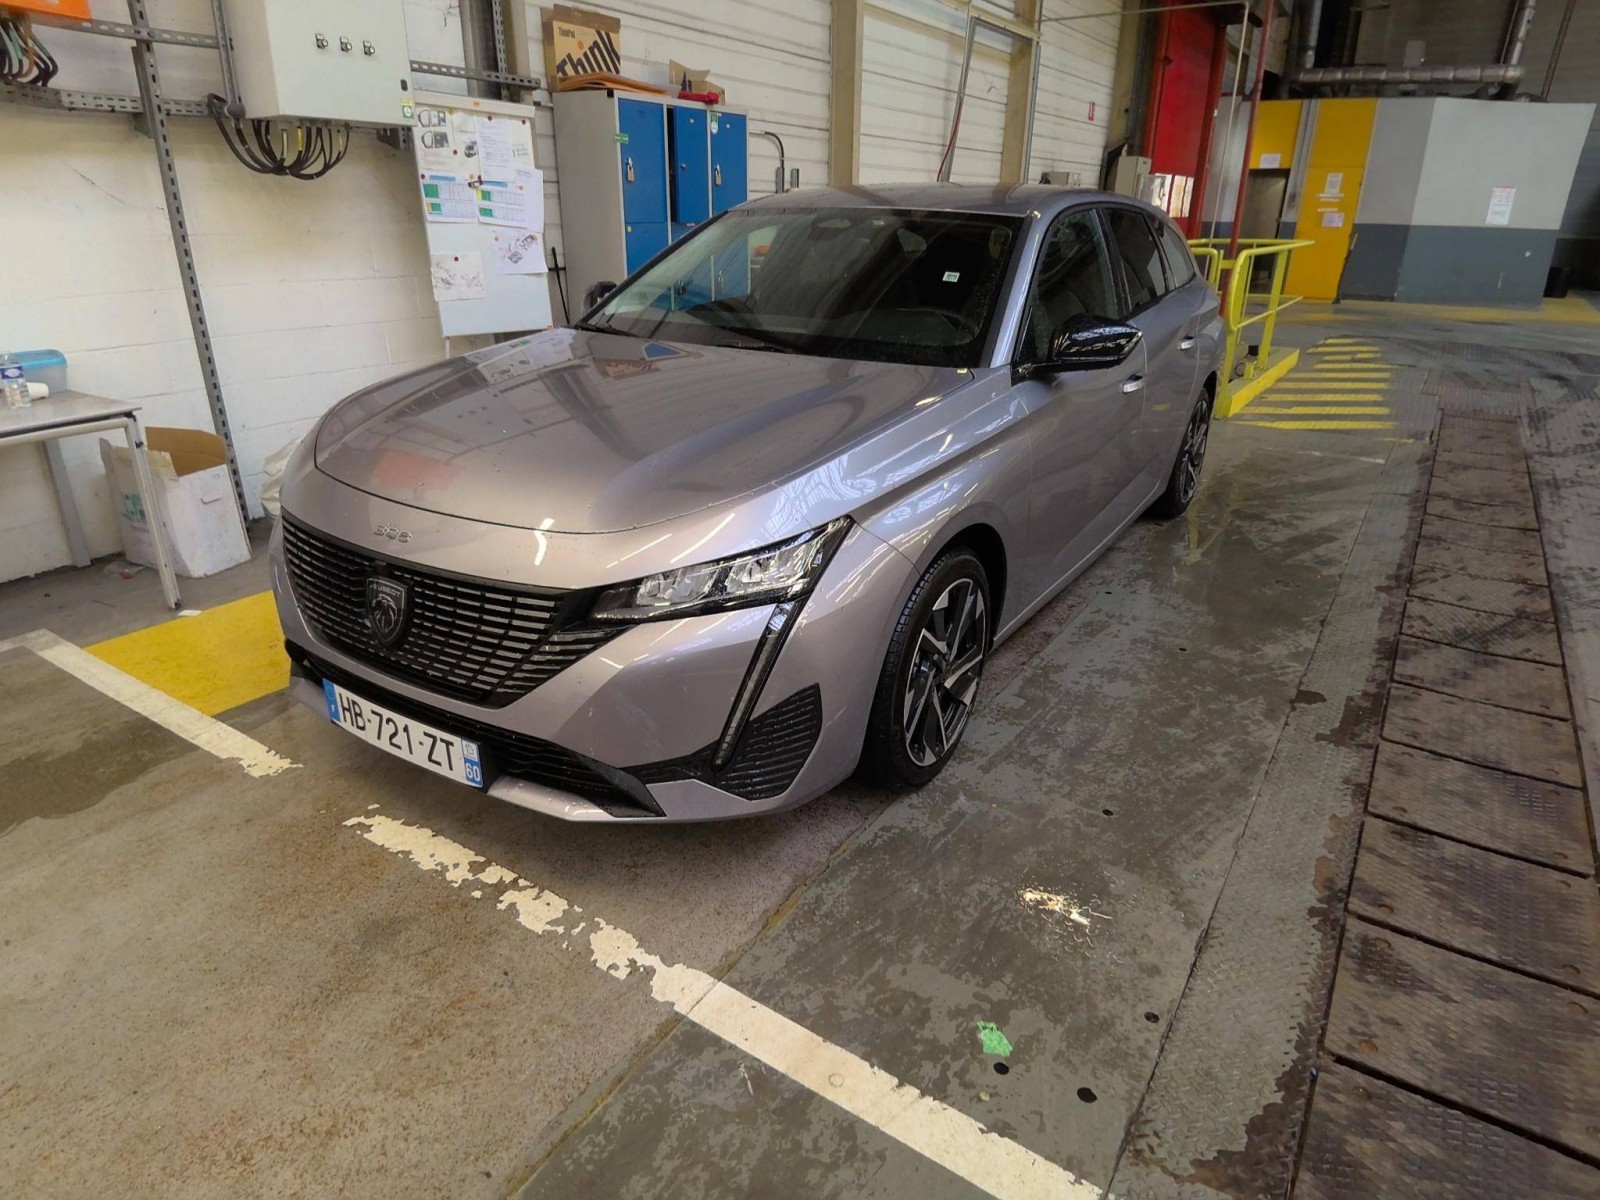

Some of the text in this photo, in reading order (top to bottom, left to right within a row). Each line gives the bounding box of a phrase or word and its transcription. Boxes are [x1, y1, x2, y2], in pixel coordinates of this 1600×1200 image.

[373, 524, 412, 544] 308
[338, 692, 456, 772] HB-721-ZT
[465, 762, 480, 782] 60
